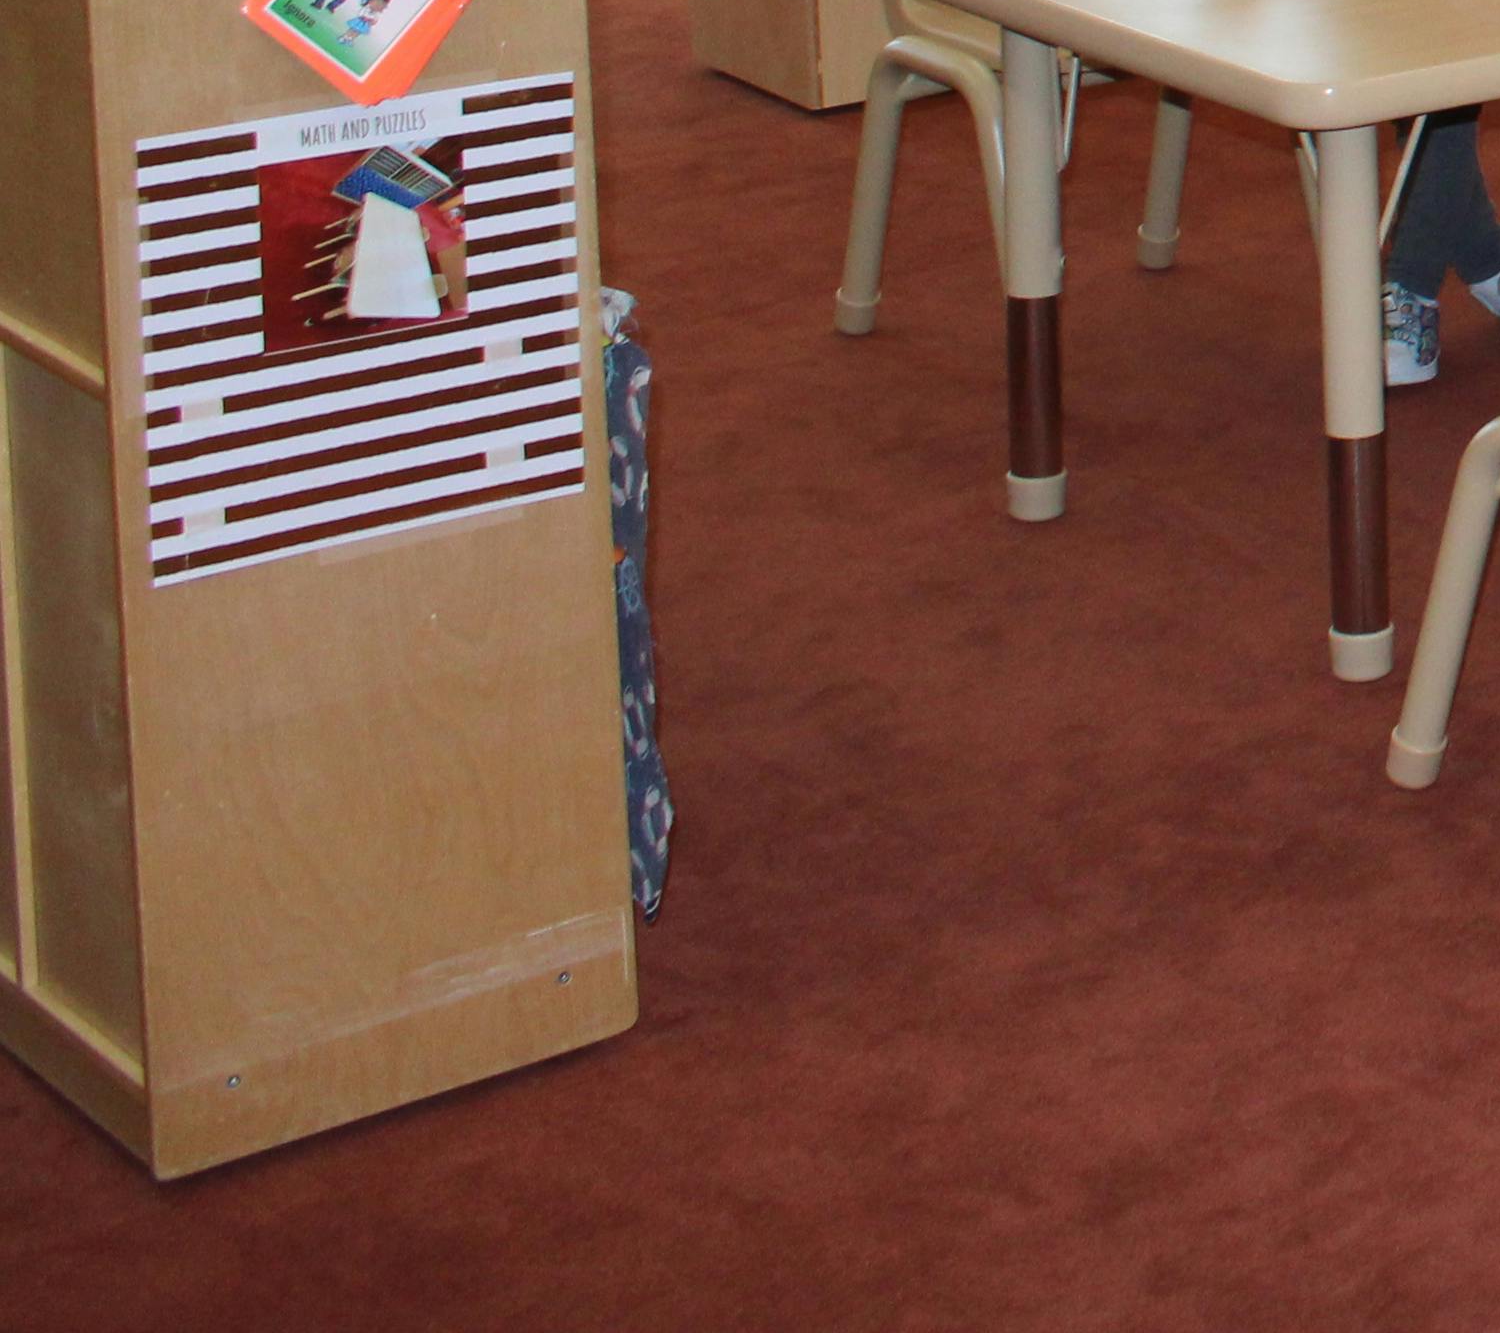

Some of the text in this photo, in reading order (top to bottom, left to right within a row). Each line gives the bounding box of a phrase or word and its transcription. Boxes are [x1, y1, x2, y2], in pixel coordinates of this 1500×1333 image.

[300, 108, 427, 148] MATH AND PUZZLES
